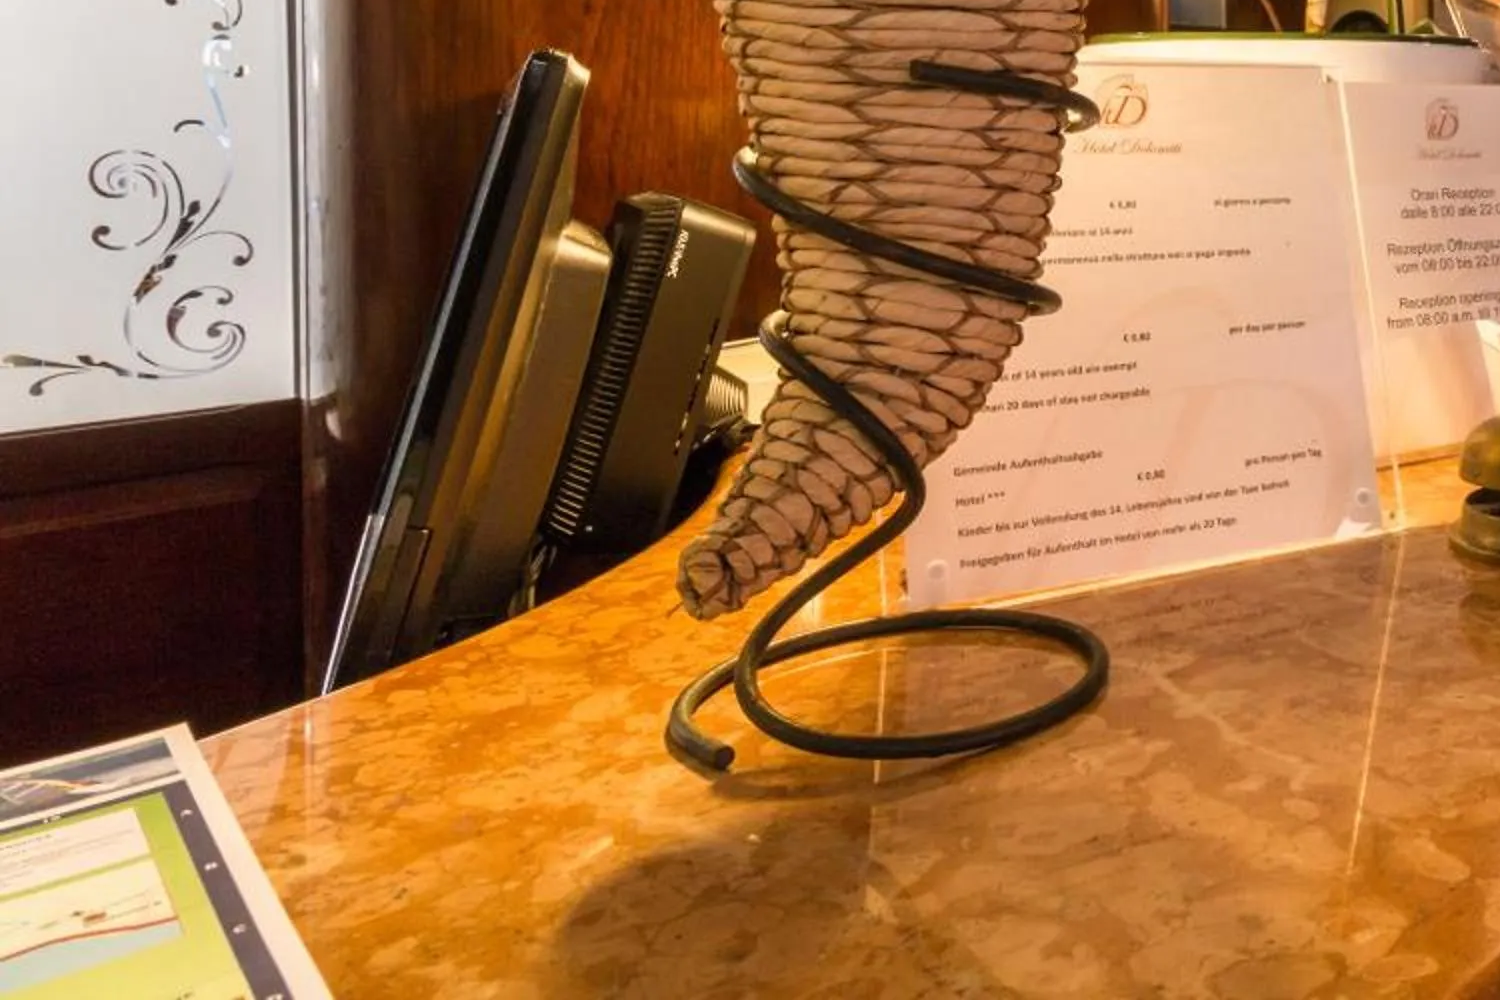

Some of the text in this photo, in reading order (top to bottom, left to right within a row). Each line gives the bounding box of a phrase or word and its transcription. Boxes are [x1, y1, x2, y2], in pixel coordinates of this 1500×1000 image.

[1441, 186, 1496, 201] Reception
[1386, 241, 1444, 257] Rezeption
[1398, 294, 1457, 309] Reception
[1387, 316, 1415, 329] from
[1021, 398, 1044, 410] days
[957, 525, 993, 538] Kinder
[995, 522, 1010, 533] bis
[1031, 509, 1089, 528] Vollendung
[1027, 547, 1042, 559] für
[1045, 537, 1097, 556] Aufenthalt
